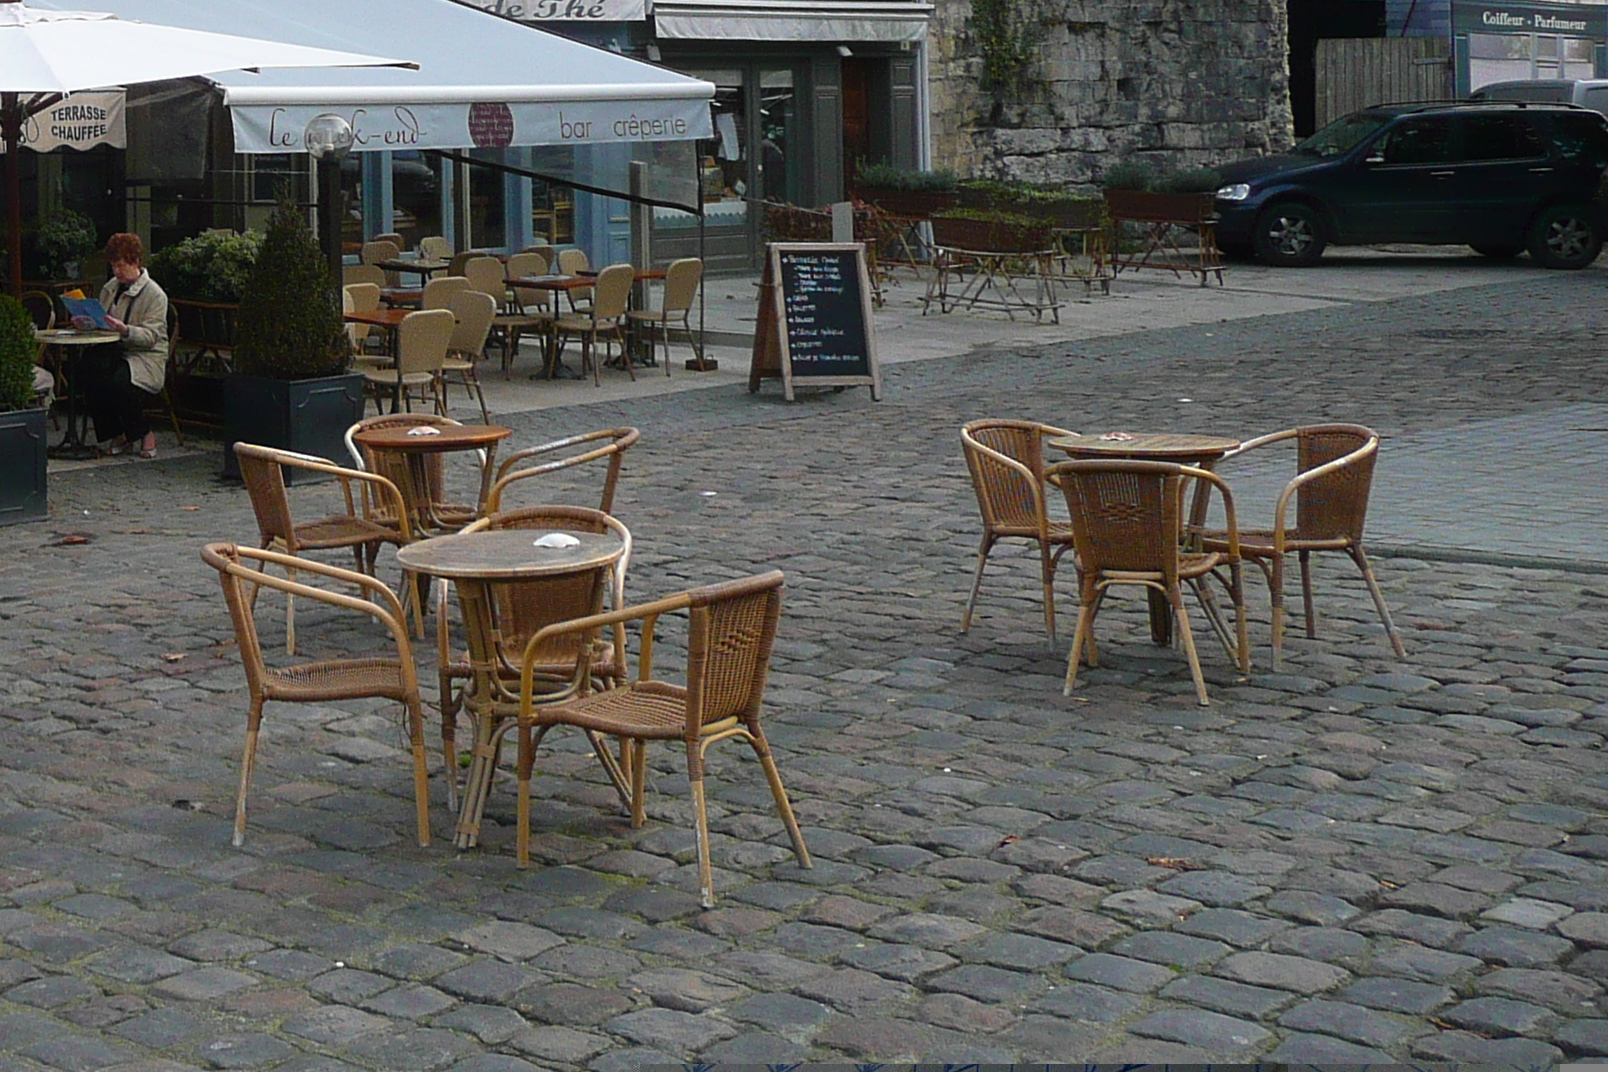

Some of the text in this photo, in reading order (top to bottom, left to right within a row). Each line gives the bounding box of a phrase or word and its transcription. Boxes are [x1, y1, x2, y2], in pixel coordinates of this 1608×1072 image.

[1483, 11, 1587, 32] Coiffeur Parfumeur
[51, 105, 107, 121] TERRASSE
[269, 108, 298, 147] le
[560, 112, 687, 143] bar crêperie
